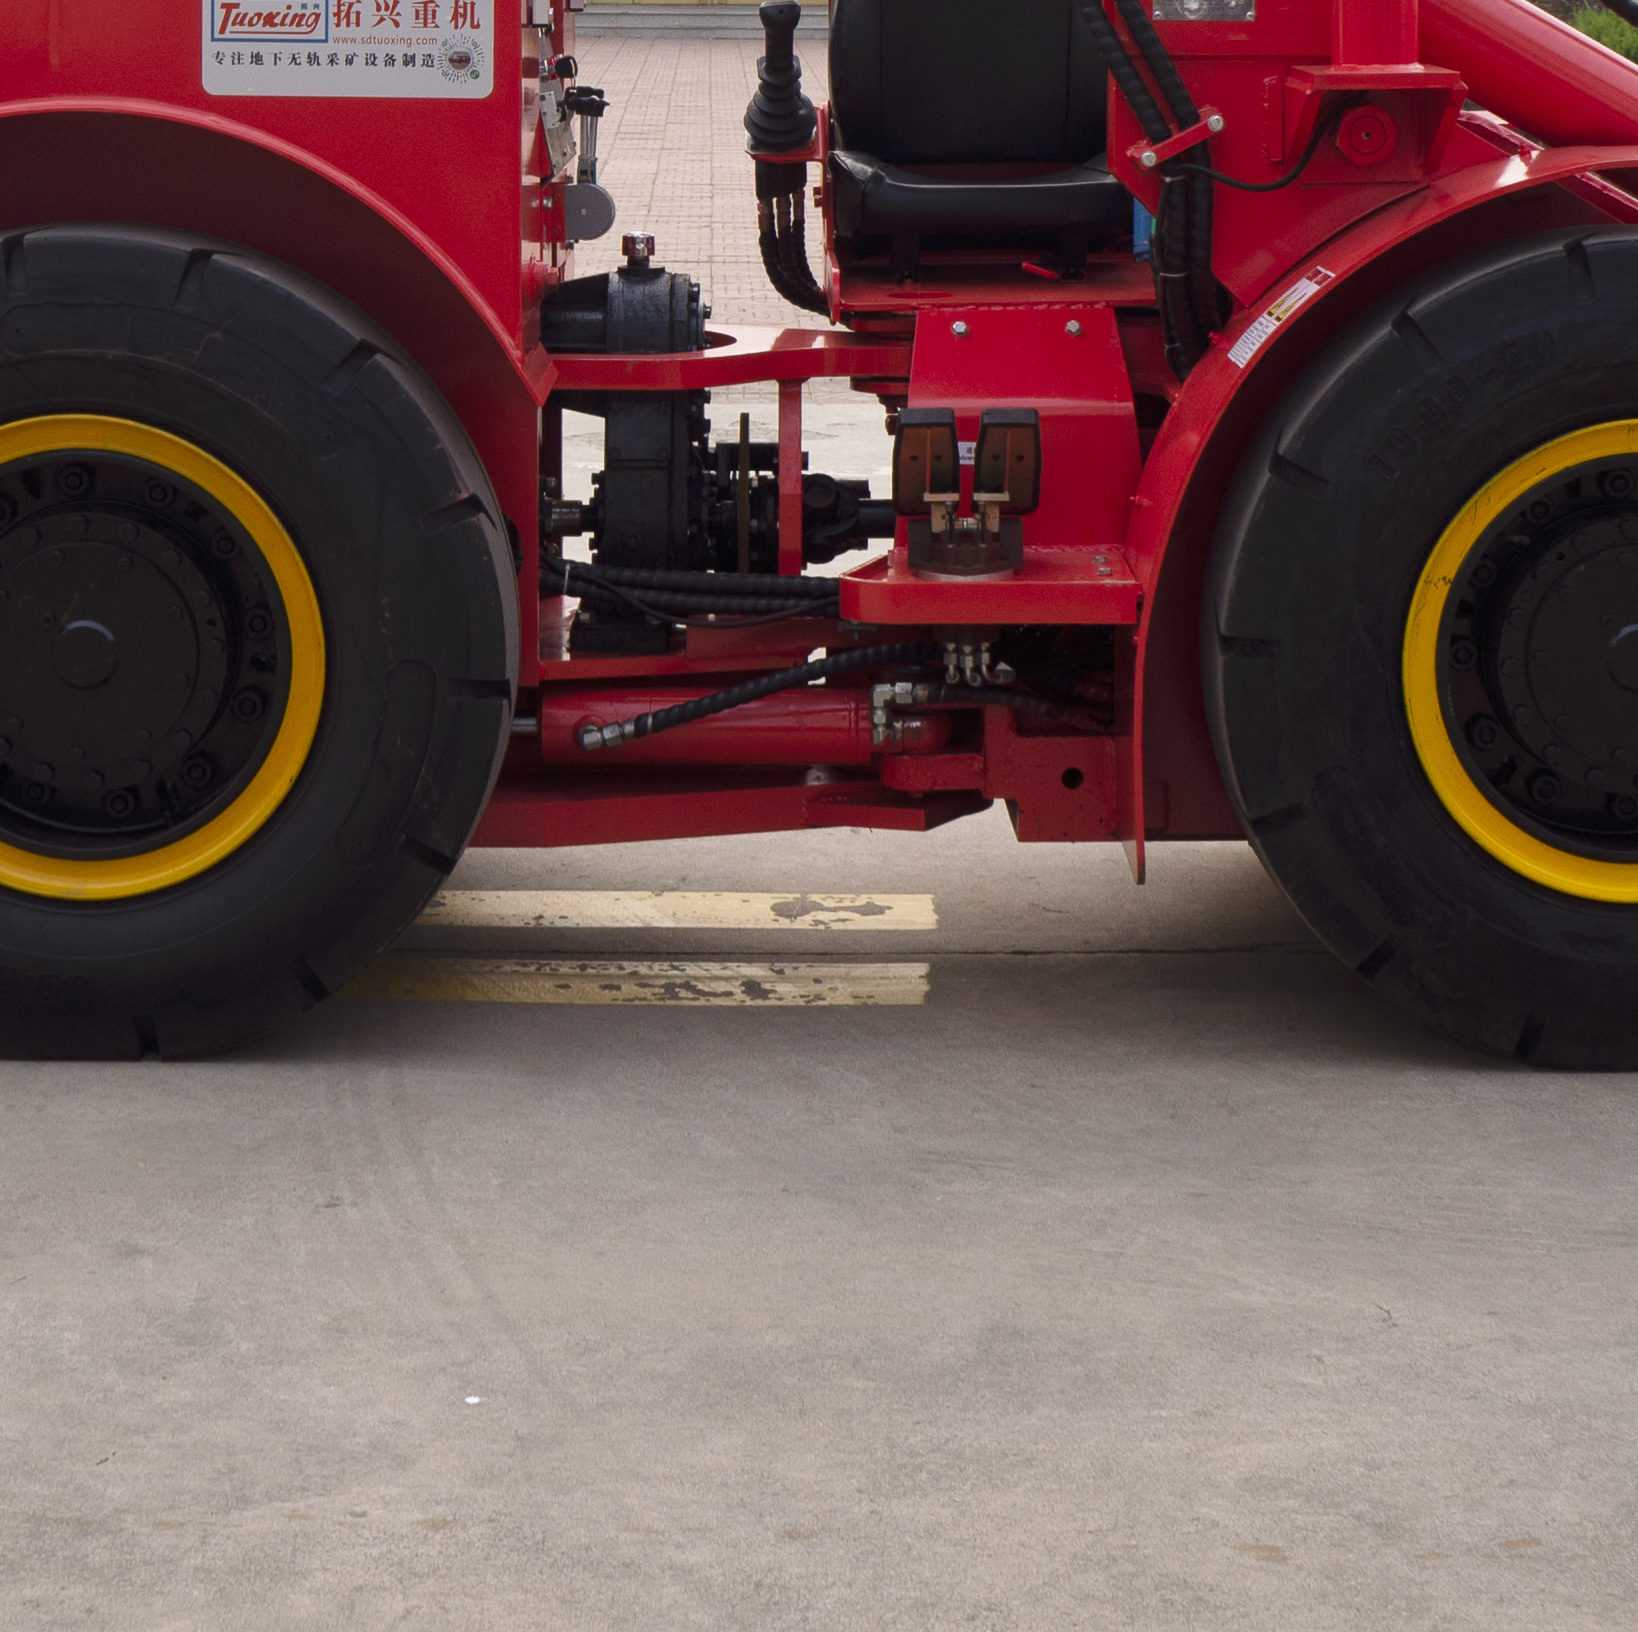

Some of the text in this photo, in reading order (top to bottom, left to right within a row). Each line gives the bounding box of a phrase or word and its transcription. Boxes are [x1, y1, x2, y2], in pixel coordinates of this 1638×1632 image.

[218, 2, 322, 35] Tuoxing
[332, 35, 438, 47] www.sdtuoxing.com
[211, 50, 436, 68] 专注地下无轨采矿设备制造
